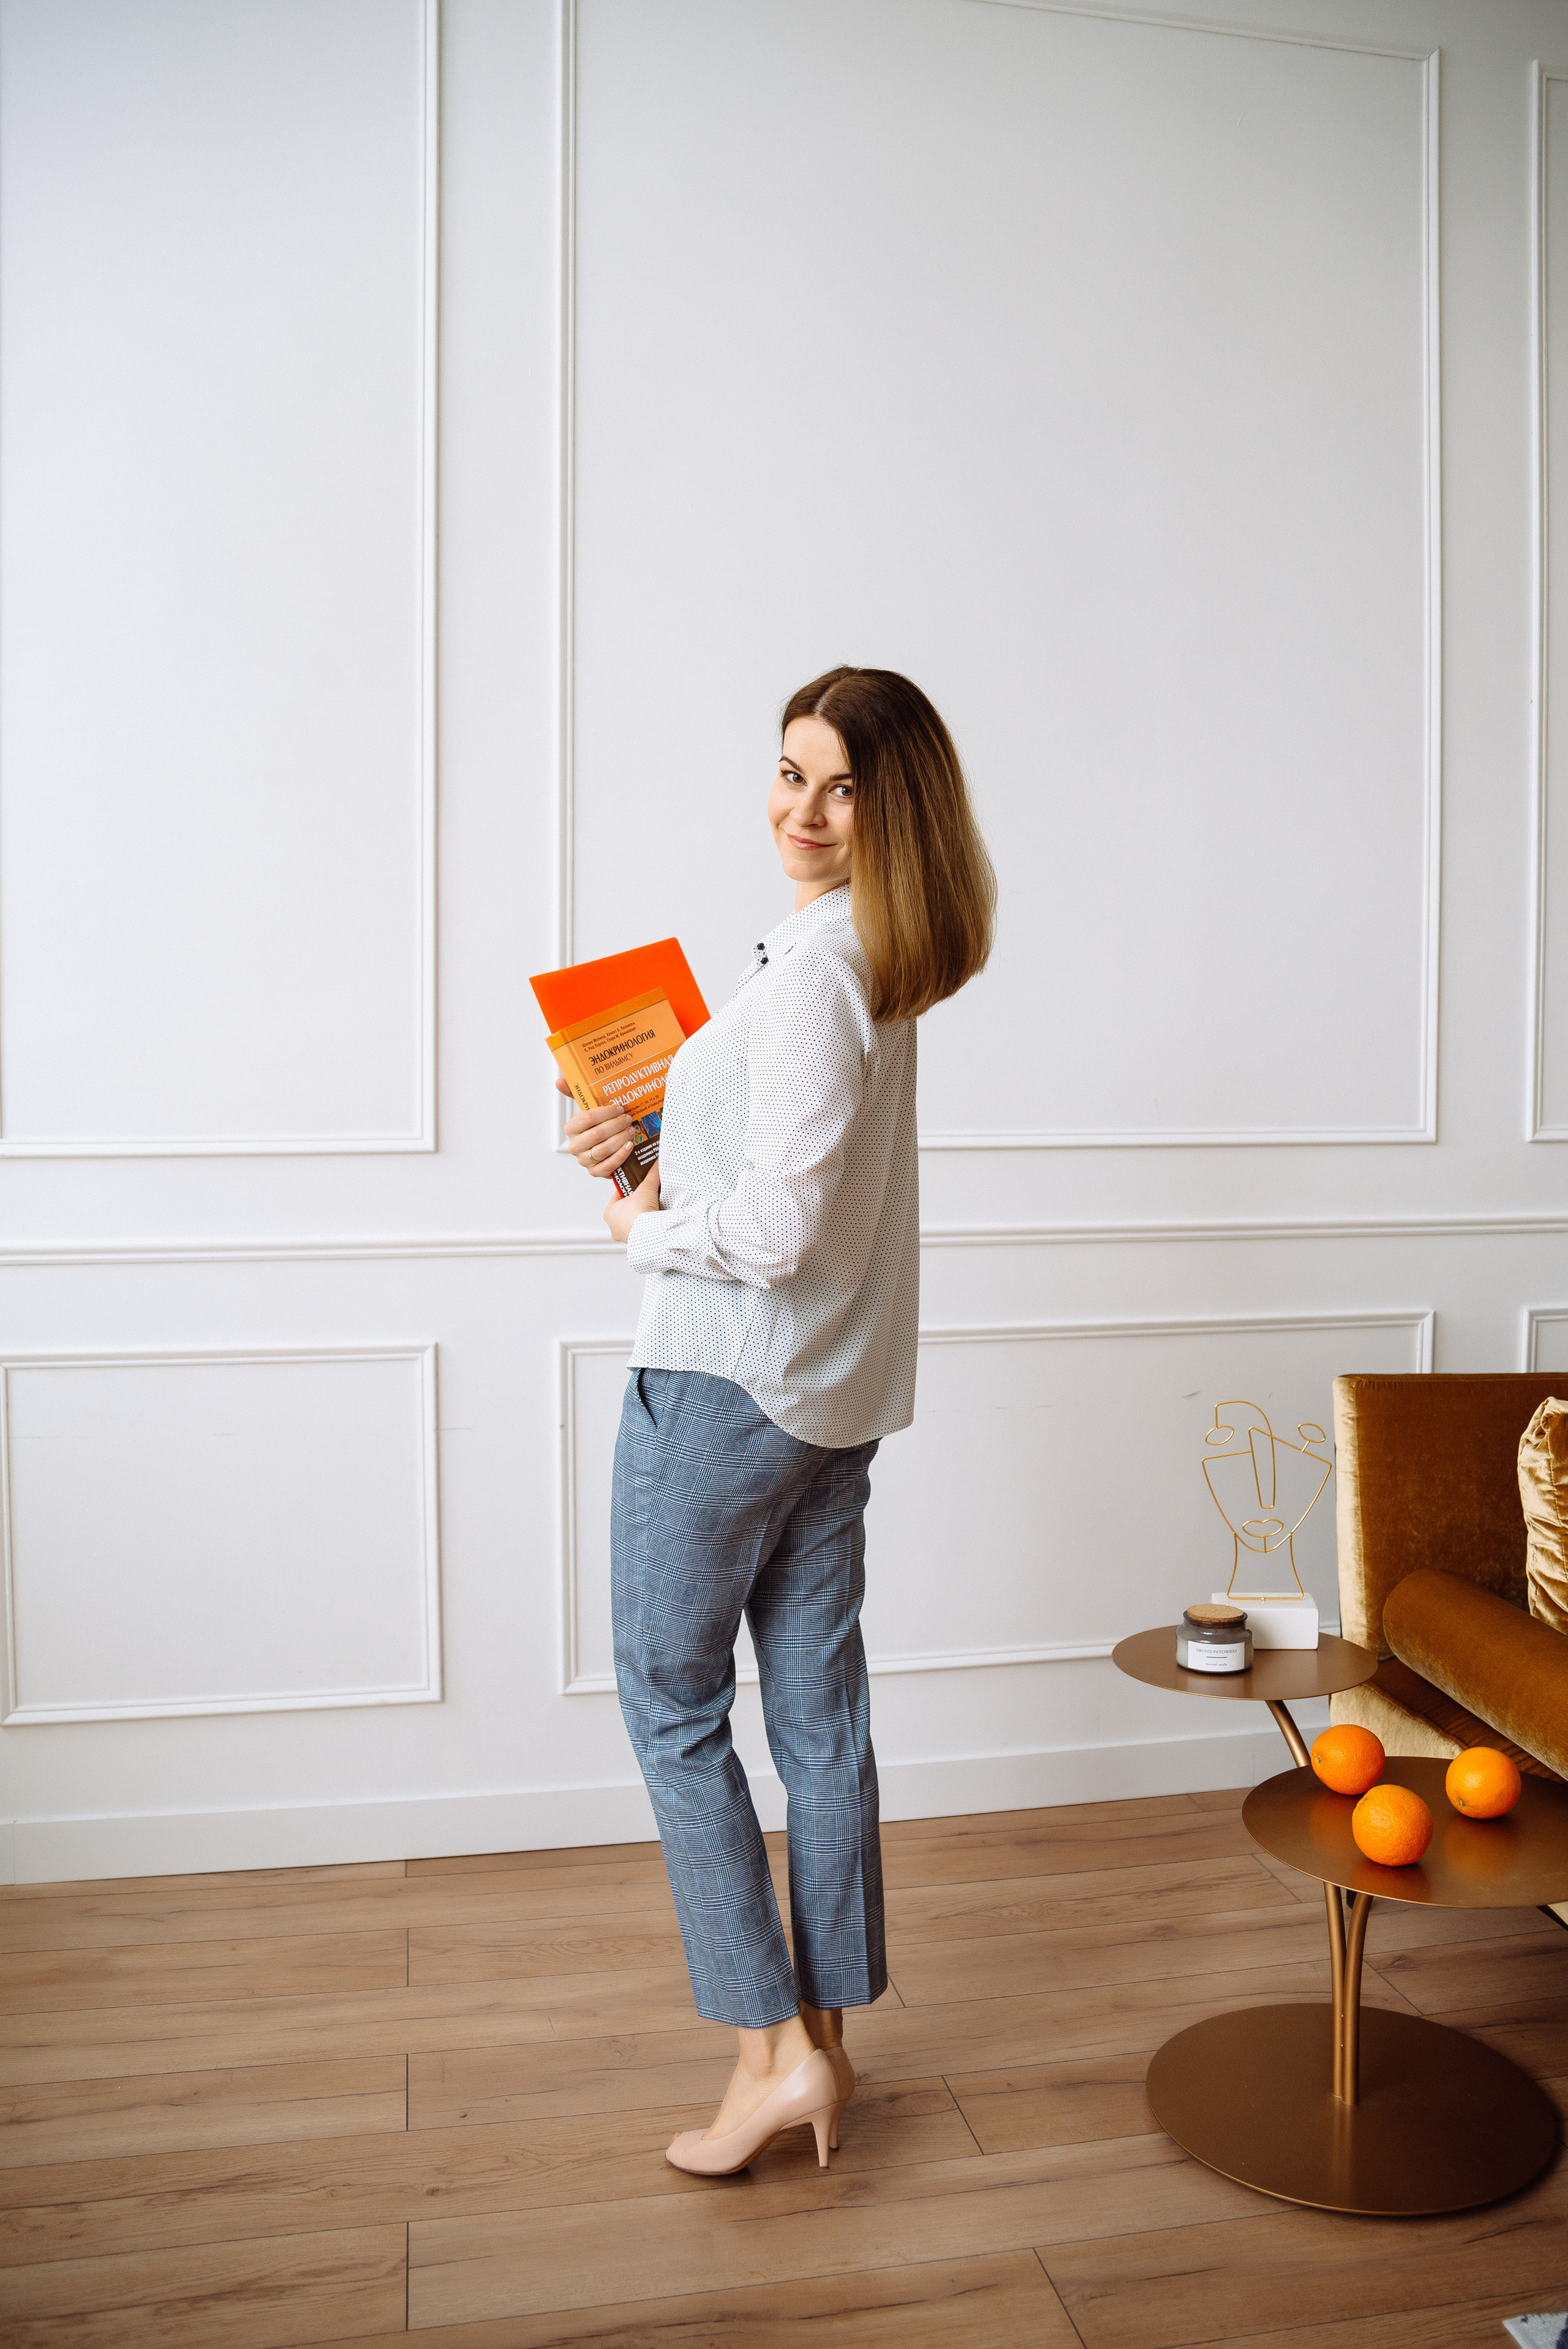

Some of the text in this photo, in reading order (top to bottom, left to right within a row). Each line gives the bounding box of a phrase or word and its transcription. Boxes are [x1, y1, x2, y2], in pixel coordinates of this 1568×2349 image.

[588, 1029, 656, 1066] ЭНДОКРИНОЛОГИЯ
[594, 1051, 633, 1076] ПО ВИЛЬЯМСУ
[602, 1054, 674, 1097] РЕПРОДУКТИВНАЯ
[574, 1083, 590, 1111] ЭНДОКРИ
[617, 1167, 634, 1196] КТИВНАЯ
